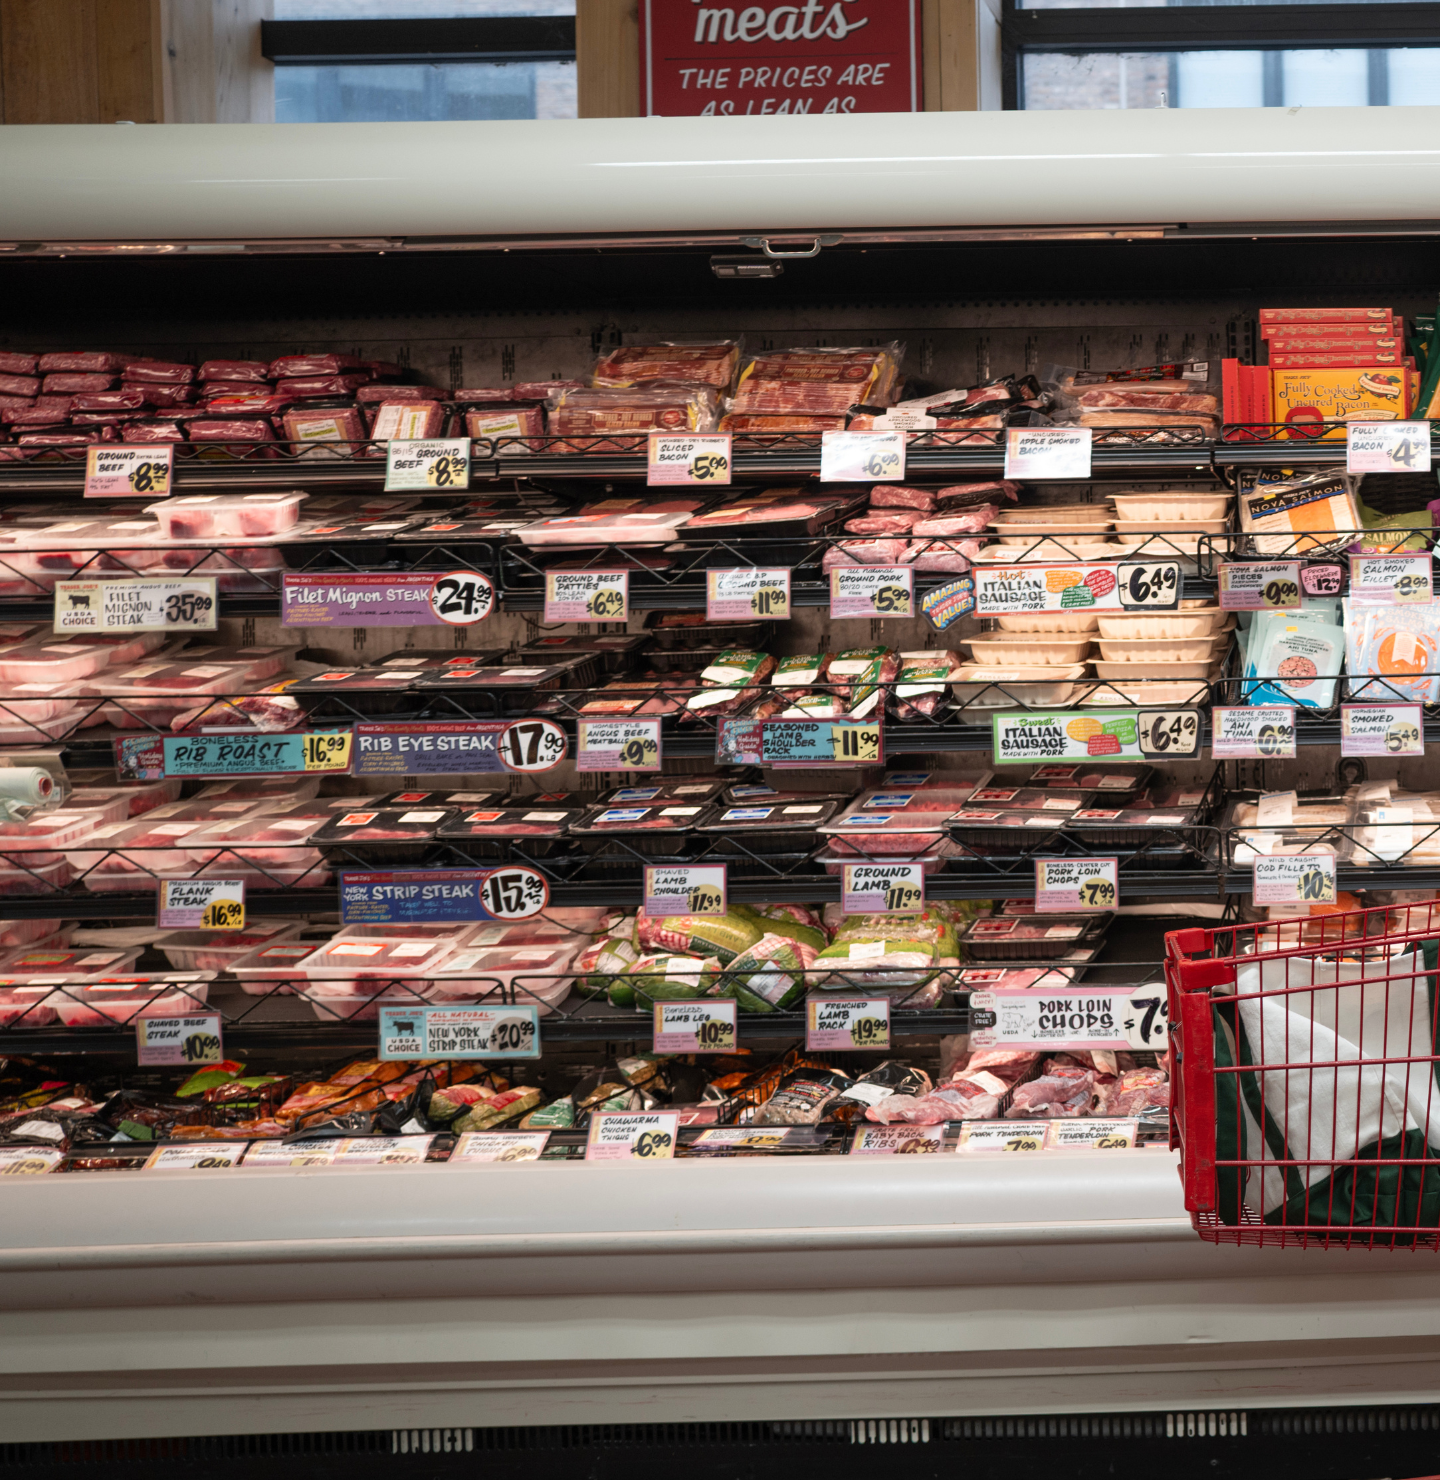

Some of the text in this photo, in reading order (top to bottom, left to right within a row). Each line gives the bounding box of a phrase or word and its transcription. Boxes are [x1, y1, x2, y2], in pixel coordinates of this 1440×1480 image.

[694, 0, 869, 43] meats
[679, 63, 891, 89] THE PRICES ARE
[700, 100, 735, 117] AS
[822, 97, 857, 115] AS
[1279, 382, 1361, 400] Fully Cooked
[1287, 398, 1370, 417] Uncured Bacon
[1352, 442, 1384, 450] BACON
[97, 452, 135, 461] GROUND
[417, 448, 459, 458] GROUND
[98, 464, 125, 472] BEEF
[394, 460, 423, 469] BEEF
[1251, 484, 1344, 514] NOVA SALMON
[1365, 530, 1411, 543] SALMON
[1362, 565, 1405, 573] SALMON
[555, 574, 624, 583] GROUND BEEF
[839, 574, 903, 583] GROUND PORK
[998, 570, 1026, 581] Hot
[759, 580, 785, 588] BEEF
[983, 581, 1042, 592] ITALIAN
[109, 592, 141, 602] FILET
[285, 586, 430, 610] Filet Mignon STEAK
[431, 578, 493, 616] $24.99
[978, 591, 1047, 604] SAUSAGE
[105, 602, 152, 614] MIGNON
[62, 617, 96, 626] CHOICE
[107, 614, 143, 626] STEAK
[1018, 717, 1055, 727] Sweet
[1351, 715, 1394, 723] SMOKED
[762, 723, 819, 732] SEASONED
[772, 732, 803, 740] LAMB
[1005, 727, 1063, 739] ITALIAN
[1224, 729, 1253, 737] TUNA
[190, 735, 259, 746] BONELESS
[358, 735, 495, 752] RIB EYE STEAK
[762, 739, 816, 748] SHOULDER
[1000, 738, 1068, 750] SAUSAGE
[174, 742, 290, 761] RIB ROAST
[763, 747, 790, 755] RACK
[1040, 748, 1064, 756] PORK
[854, 867, 911, 878] GROUND
[1047, 867, 1101, 876] PORK LOIN
[655, 877, 687, 885] LAMB
[1046, 876, 1079, 885] CHOPS
[345, 886, 367, 894] NEW
[852, 880, 891, 891] LAMB
[171, 887, 213, 896] FLANK
[372, 884, 474, 900] STRIP STEAK
[653, 886, 700, 895] SHOULDER
[169, 897, 207, 906] STEAK
[343, 893, 369, 902] YORK
[825, 1002, 868, 1010] FRENCHED
[1038, 998, 1112, 1013] PORK LOIN
[665, 1014, 711, 1022] LAMB LEG
[818, 1010, 850, 1020] LAMB
[183, 1018, 207, 1026] BEEF
[818, 1021, 846, 1030] RACK
[1038, 1013, 1114, 1029] CHOPS
[146, 1030, 181, 1039] STEAK
[428, 1026, 480, 1038] NEW YORK
[387, 1043, 421, 1052] CHOICE
[428, 1039, 489, 1052] STRIP STEAK
[602, 1115, 660, 1126] SHAWARMA
[601, 1126, 637, 1134] CHICKEN
[864, 1131, 925, 1140] BABY BACK
[864, 1139, 895, 1149] RIBS
